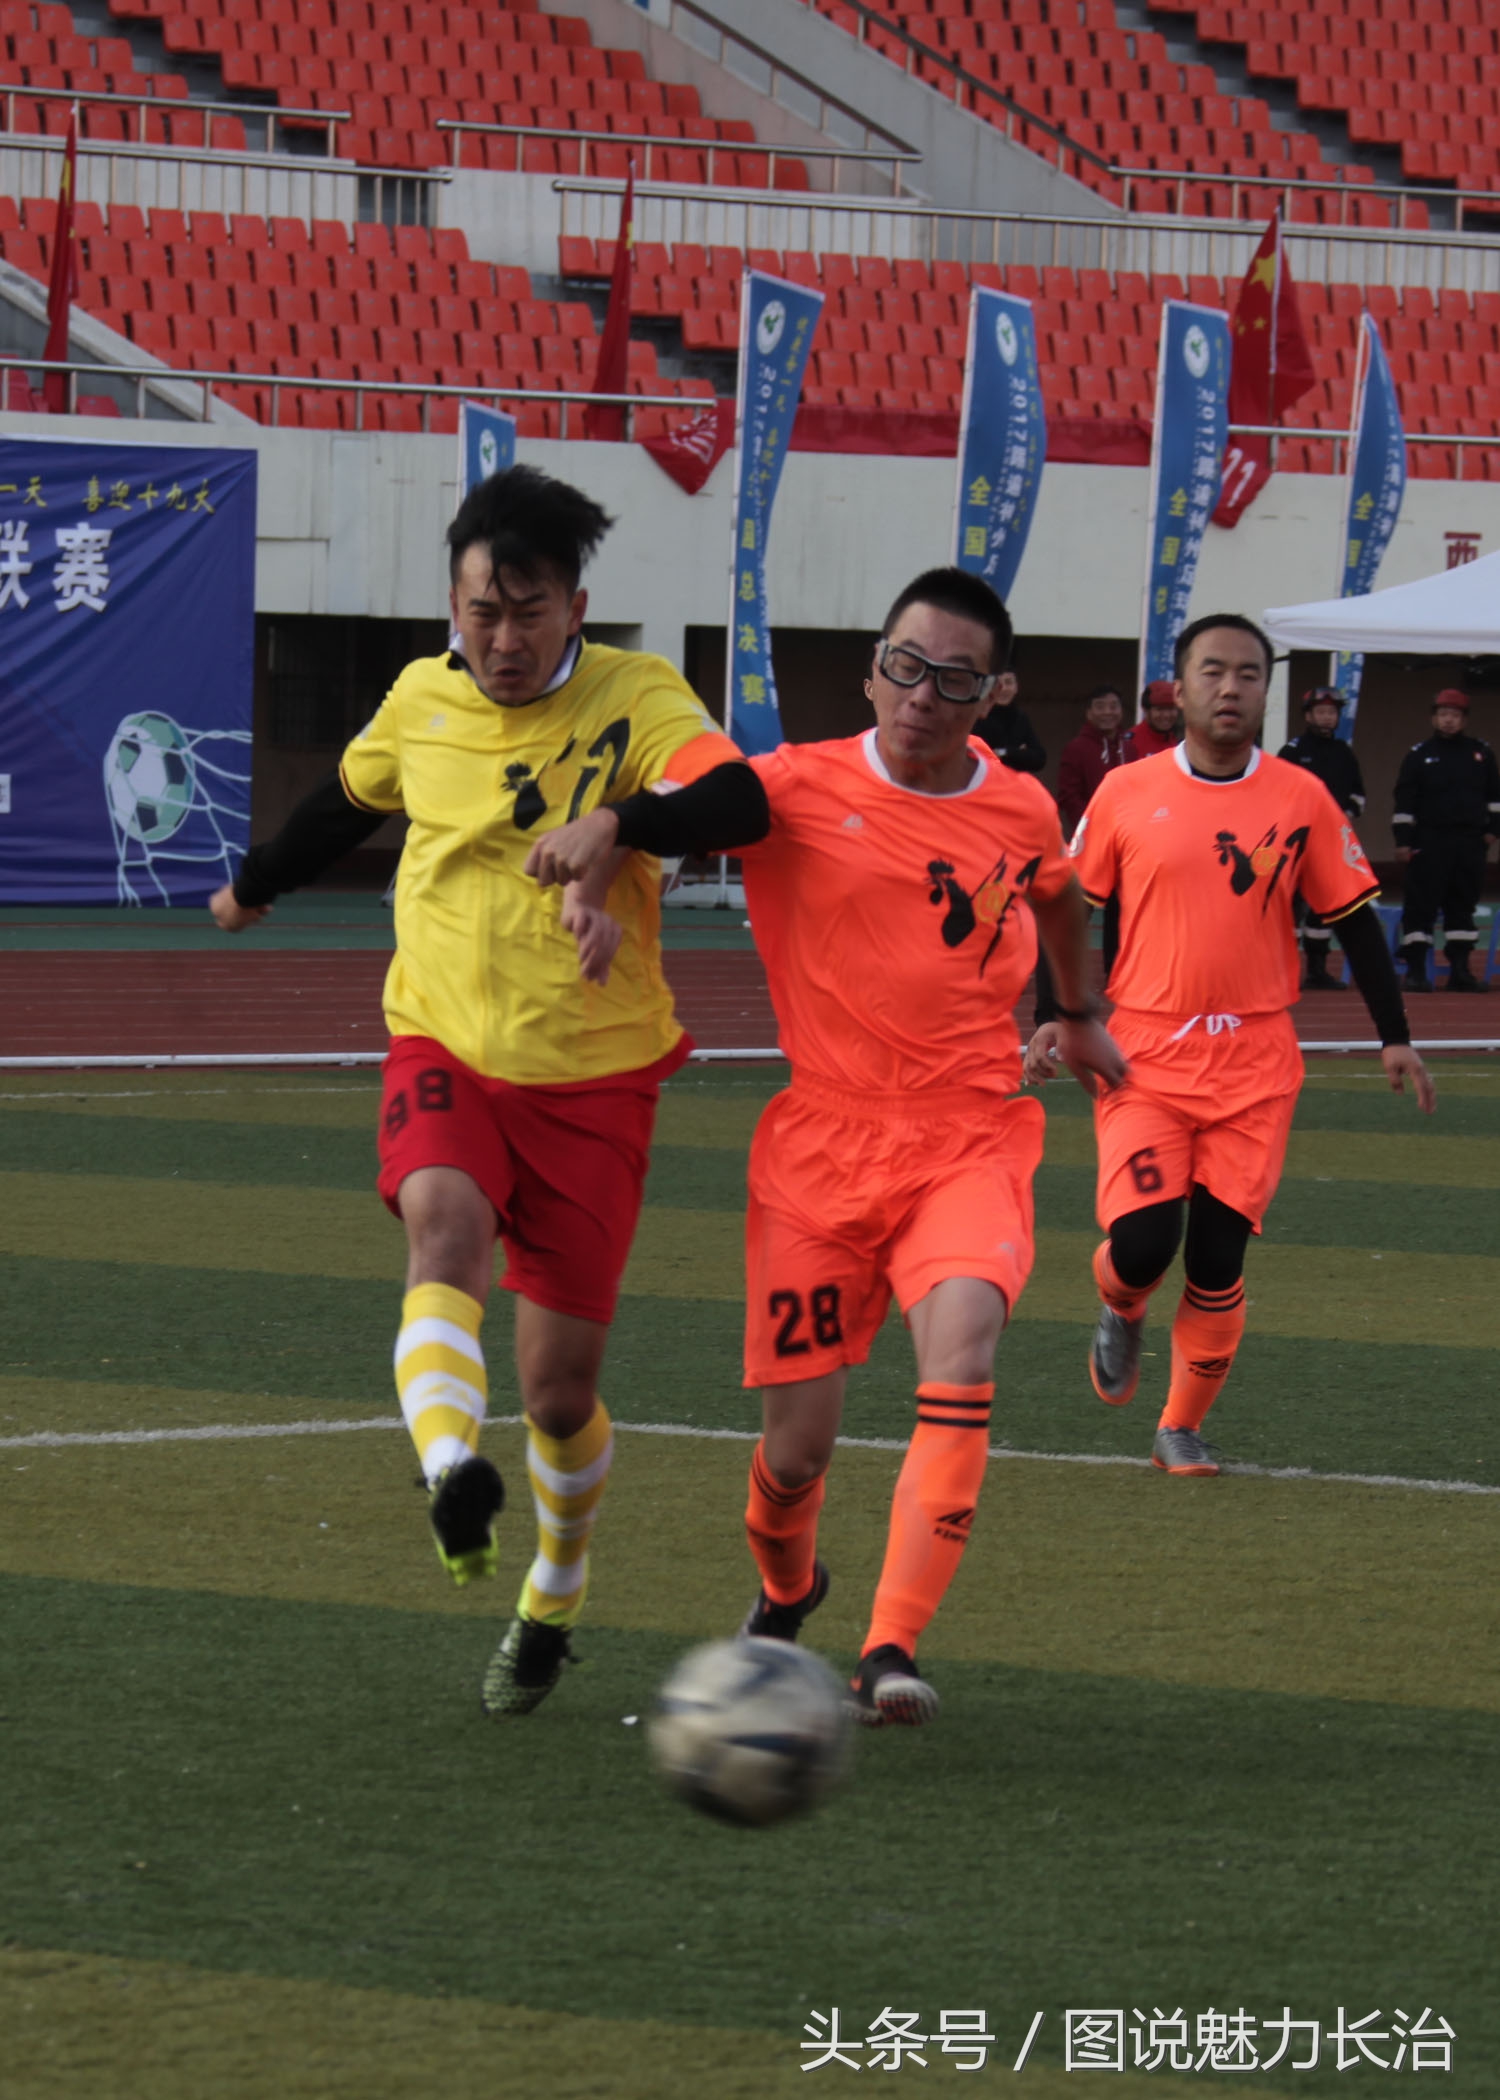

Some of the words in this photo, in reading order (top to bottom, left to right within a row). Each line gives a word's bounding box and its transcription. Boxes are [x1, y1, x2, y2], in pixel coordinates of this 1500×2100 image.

[82, 475, 215, 515] 喜迎十九大
[1128, 1147, 1164, 1195] 6
[768, 1284, 844, 1359] 28
